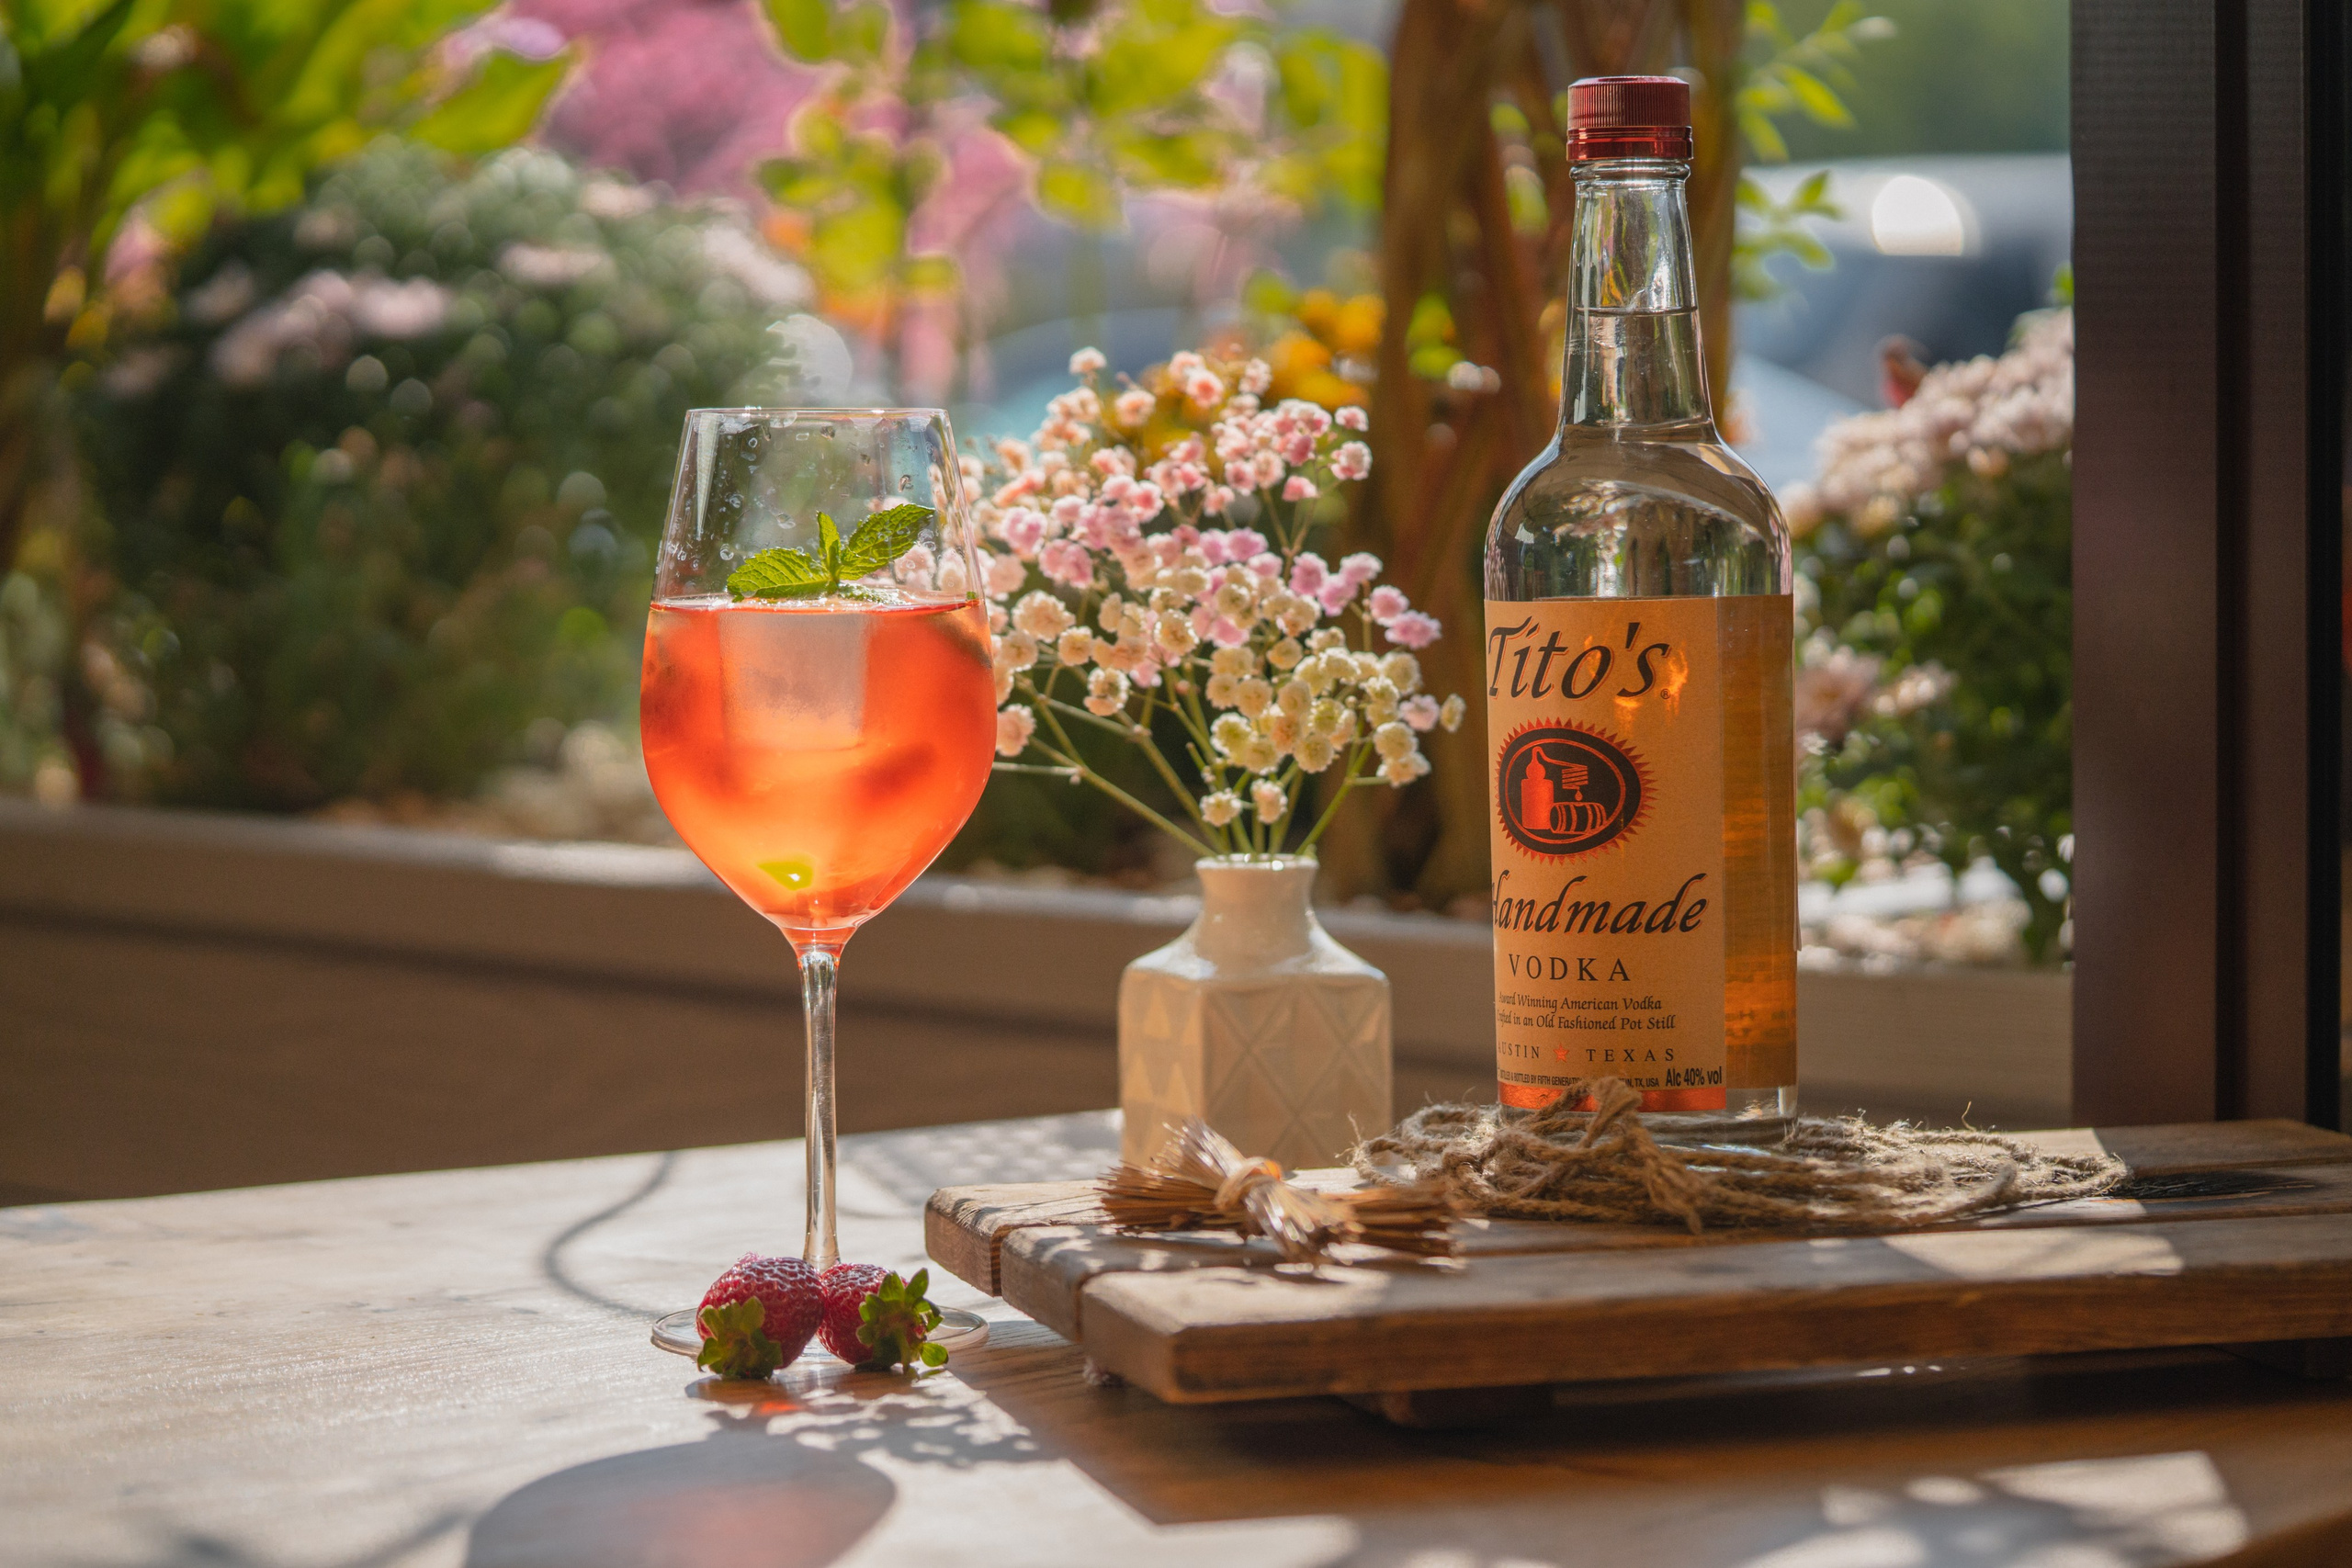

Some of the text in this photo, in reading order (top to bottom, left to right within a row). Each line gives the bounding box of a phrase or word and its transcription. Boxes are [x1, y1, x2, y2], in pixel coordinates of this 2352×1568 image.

[1488, 615, 1671, 701] Tito's
[1508, 953, 1631, 982] VODKA
[1517, 993, 1557, 1014] Winning
[1560, 997, 1619, 1011] American
[1622, 995, 1662, 1011] Vodka
[1513, 1012, 1521, 1026] in
[1522, 1016, 1534, 1028] an
[1536, 1013, 1555, 1028] Old
[1558, 1015, 1617, 1030] Fashioned
[1620, 1017, 1643, 1030] Pot
[1646, 1014, 1676, 1030] Still
[1498, 1041, 1674, 1063] AUSTIN TEXAS
[1531, 1074, 1537, 1084] BY
[1537, 1075, 1551, 1086] FIFTH
[1645, 1077, 1660, 1088] USA
[1665, 1066, 1723, 1088] Alc 40% vol
